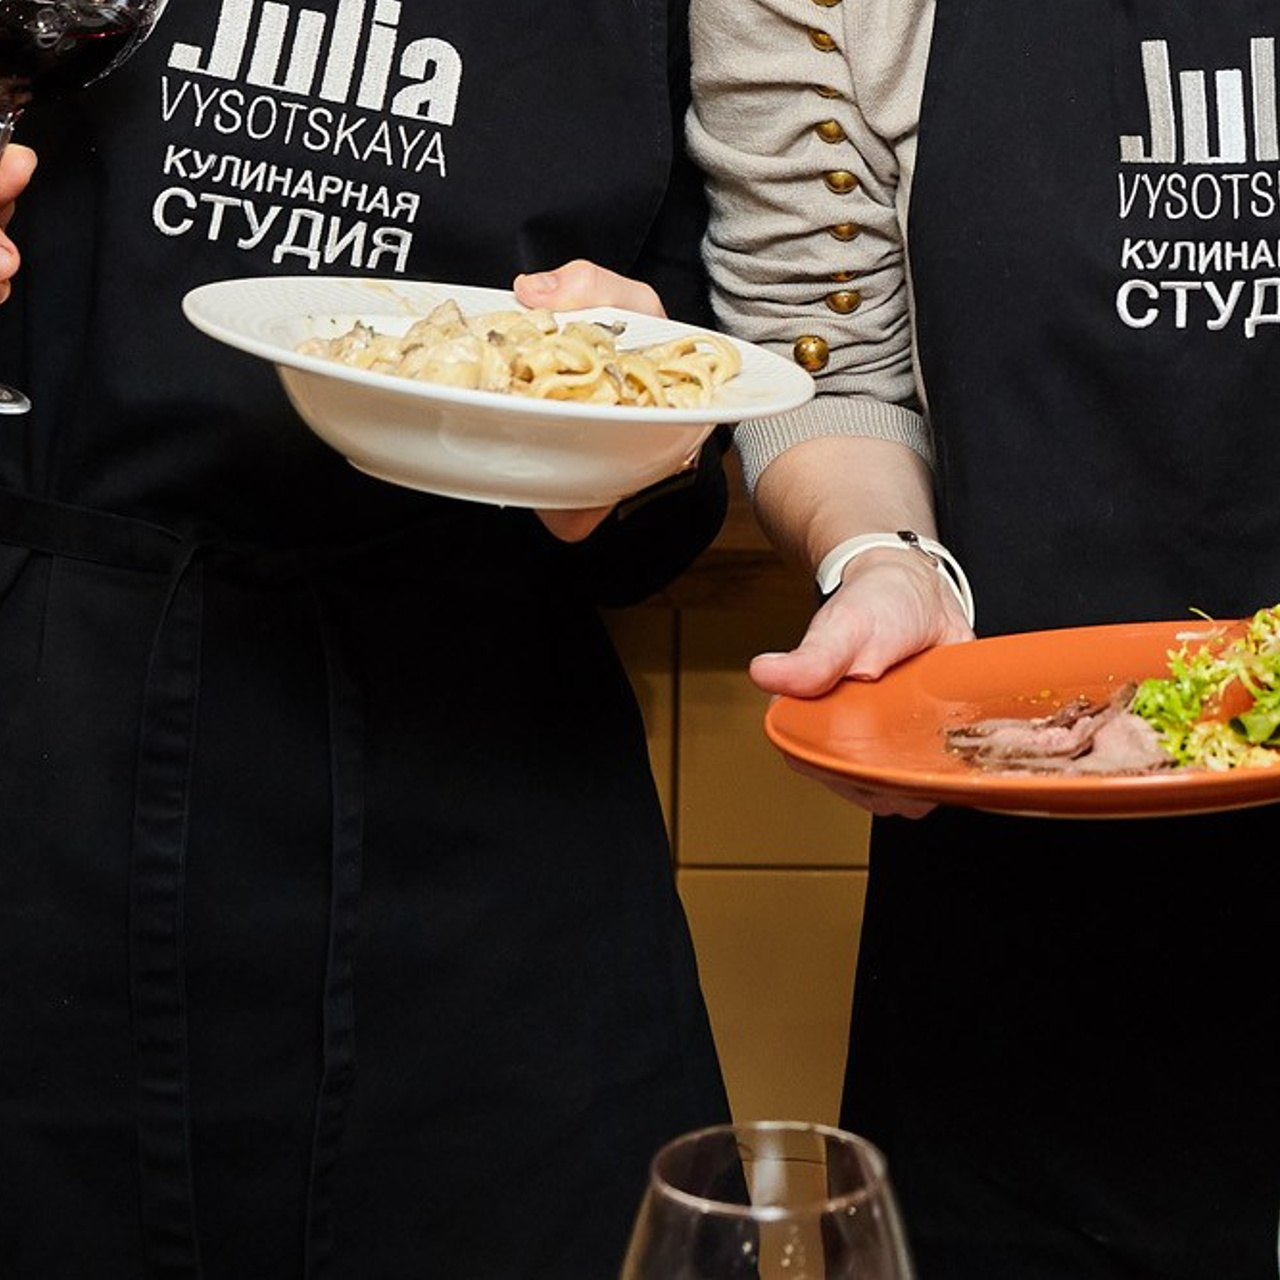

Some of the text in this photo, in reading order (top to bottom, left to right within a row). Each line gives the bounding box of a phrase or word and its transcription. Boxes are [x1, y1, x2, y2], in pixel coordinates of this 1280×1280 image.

[161, 75, 446, 177] VYSOTSKAYA
[163, 145, 420, 223] КУЛИНАРНАЯ
[153, 187, 413, 272] СТУДИЯ
